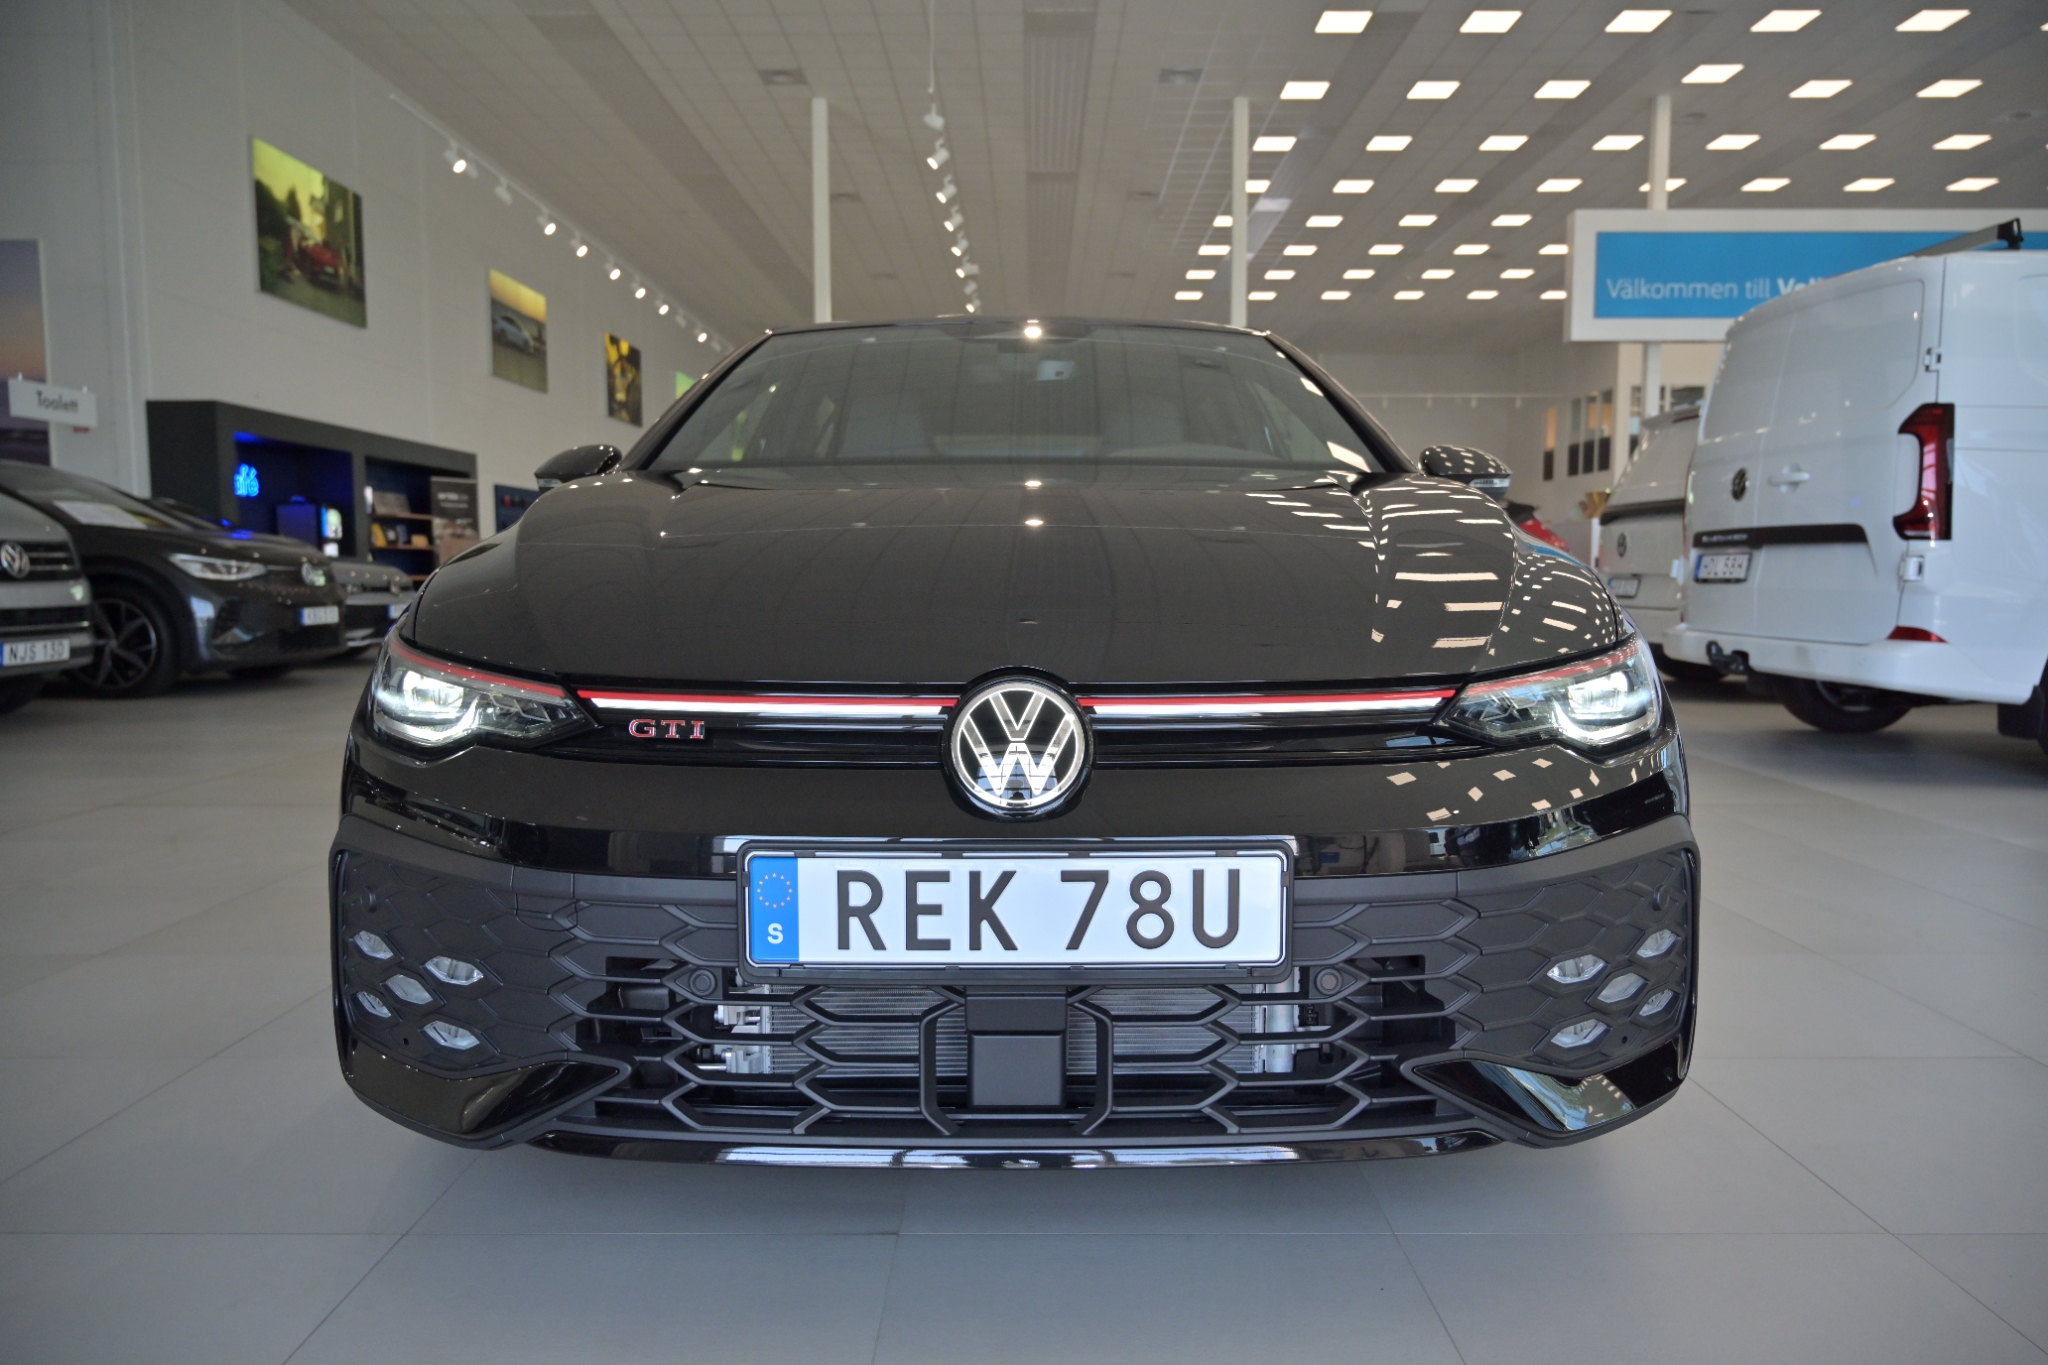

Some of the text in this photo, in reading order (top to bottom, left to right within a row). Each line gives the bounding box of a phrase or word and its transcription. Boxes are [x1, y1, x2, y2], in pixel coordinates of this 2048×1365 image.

[1606, 277, 1738, 299] Välkommen
[1745, 277, 1770, 299] till
[36, 390, 79, 414] Toalett
[9, 643, 37, 663] NJS
[628, 718, 705, 739] GTI
[837, 868, 1240, 951] REK 78U
[767, 922, 784, 944] S
